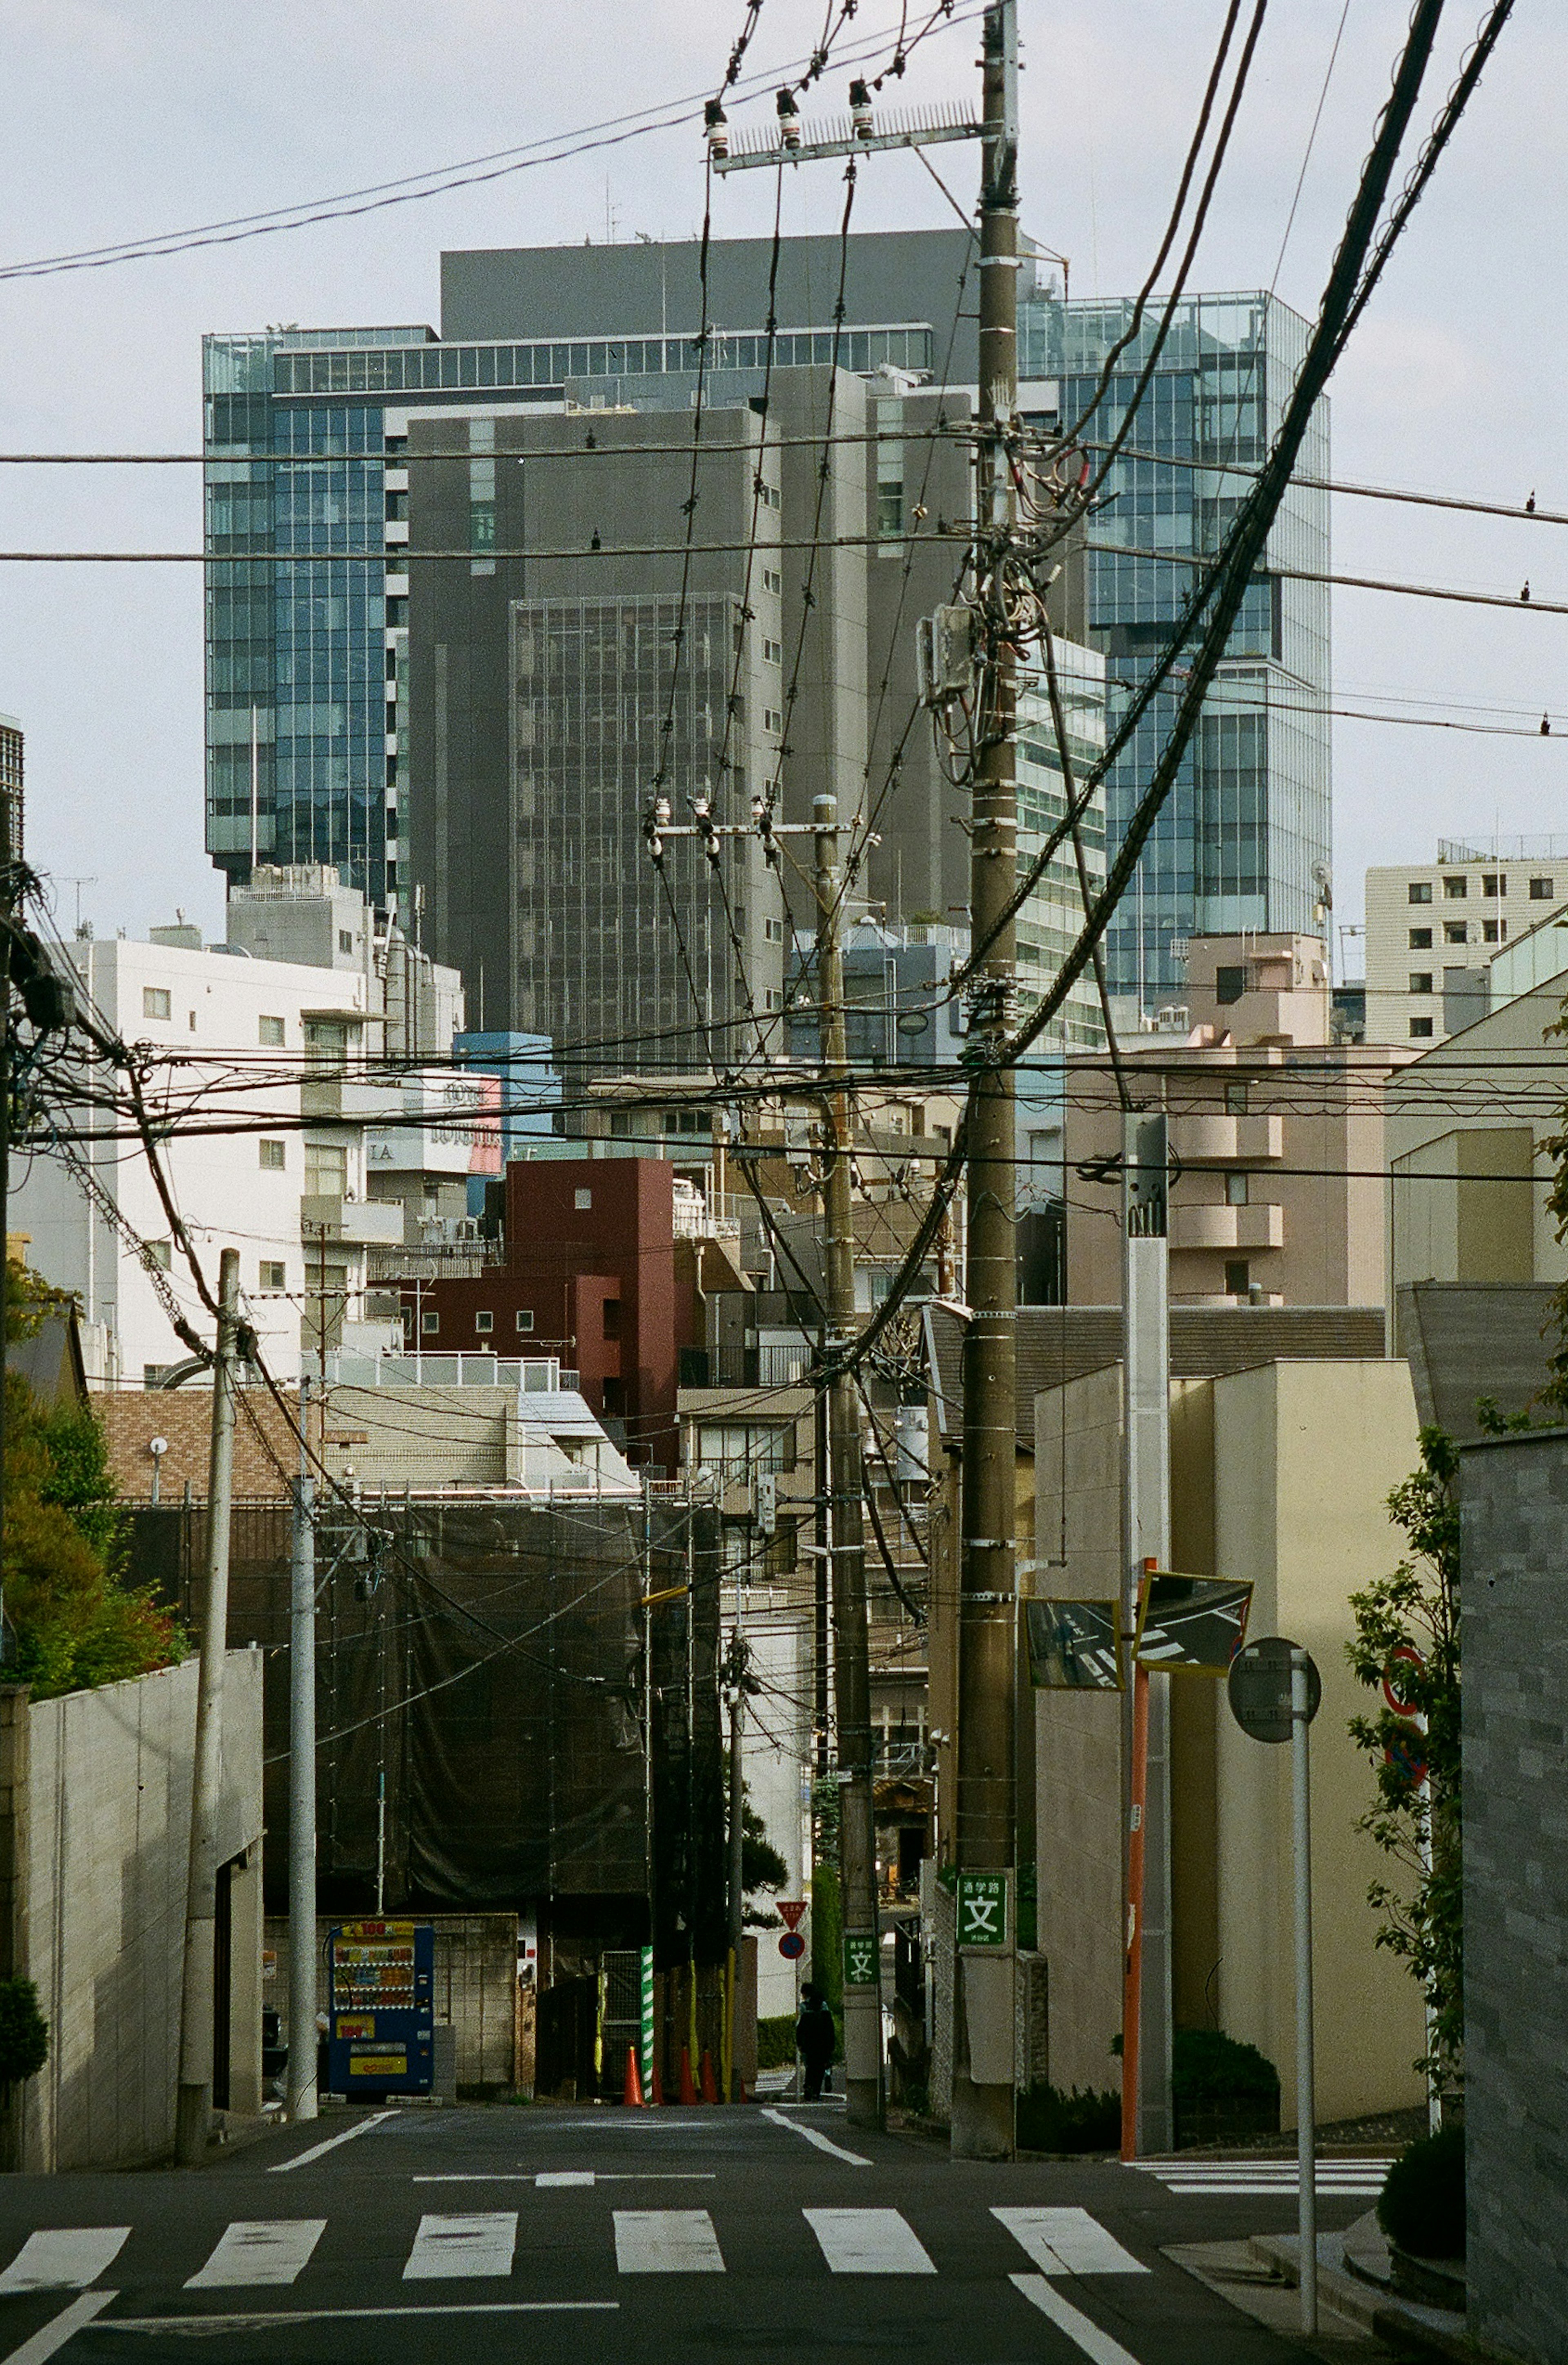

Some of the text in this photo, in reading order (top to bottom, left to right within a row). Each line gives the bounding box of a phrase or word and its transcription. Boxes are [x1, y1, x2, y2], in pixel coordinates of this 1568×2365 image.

[964, 1880, 999, 1893] 通学路
[964, 1895, 998, 1932] 文
[851, 1952, 872, 1975] 文
